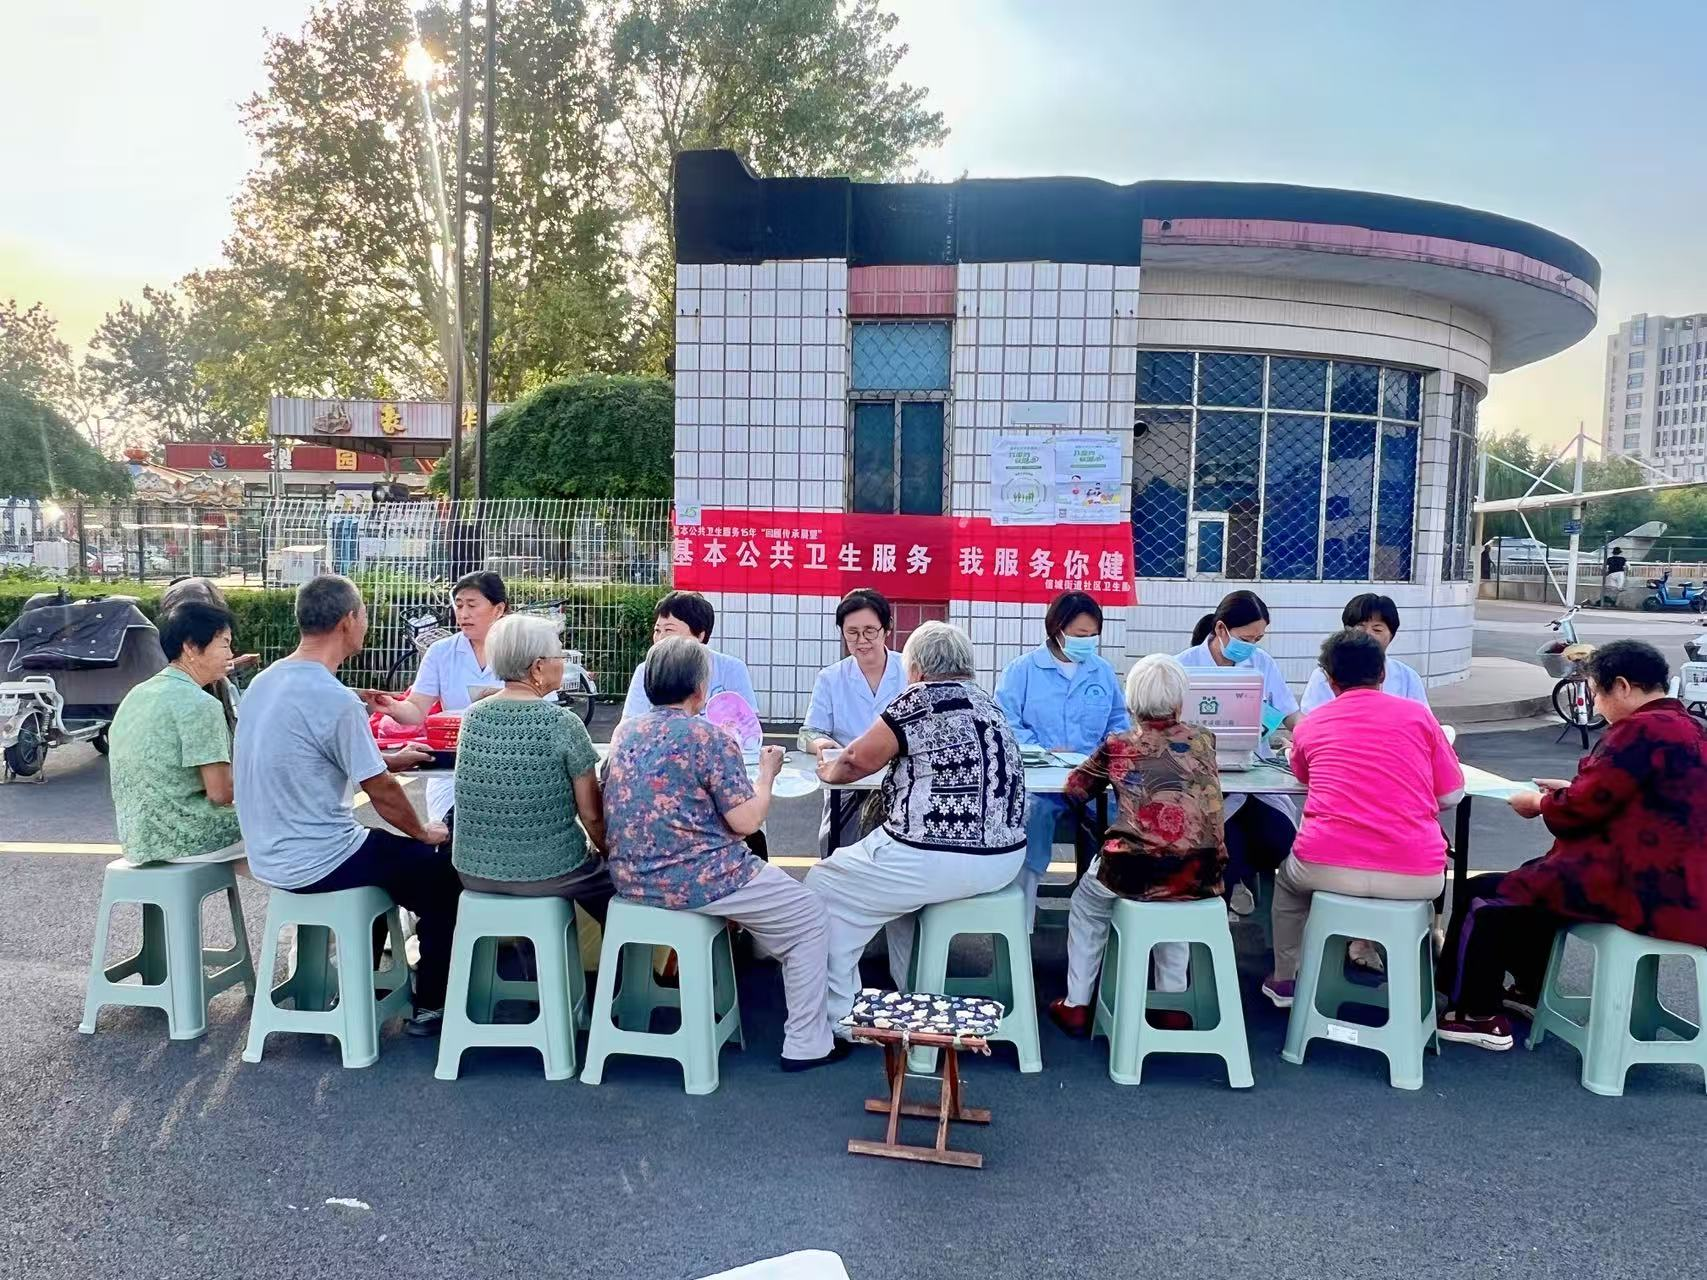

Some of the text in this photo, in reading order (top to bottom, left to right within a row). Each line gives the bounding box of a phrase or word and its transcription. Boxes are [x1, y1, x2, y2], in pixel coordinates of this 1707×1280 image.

[673, 538, 1124, 580] 基本公共卫生服务 我服务你健
